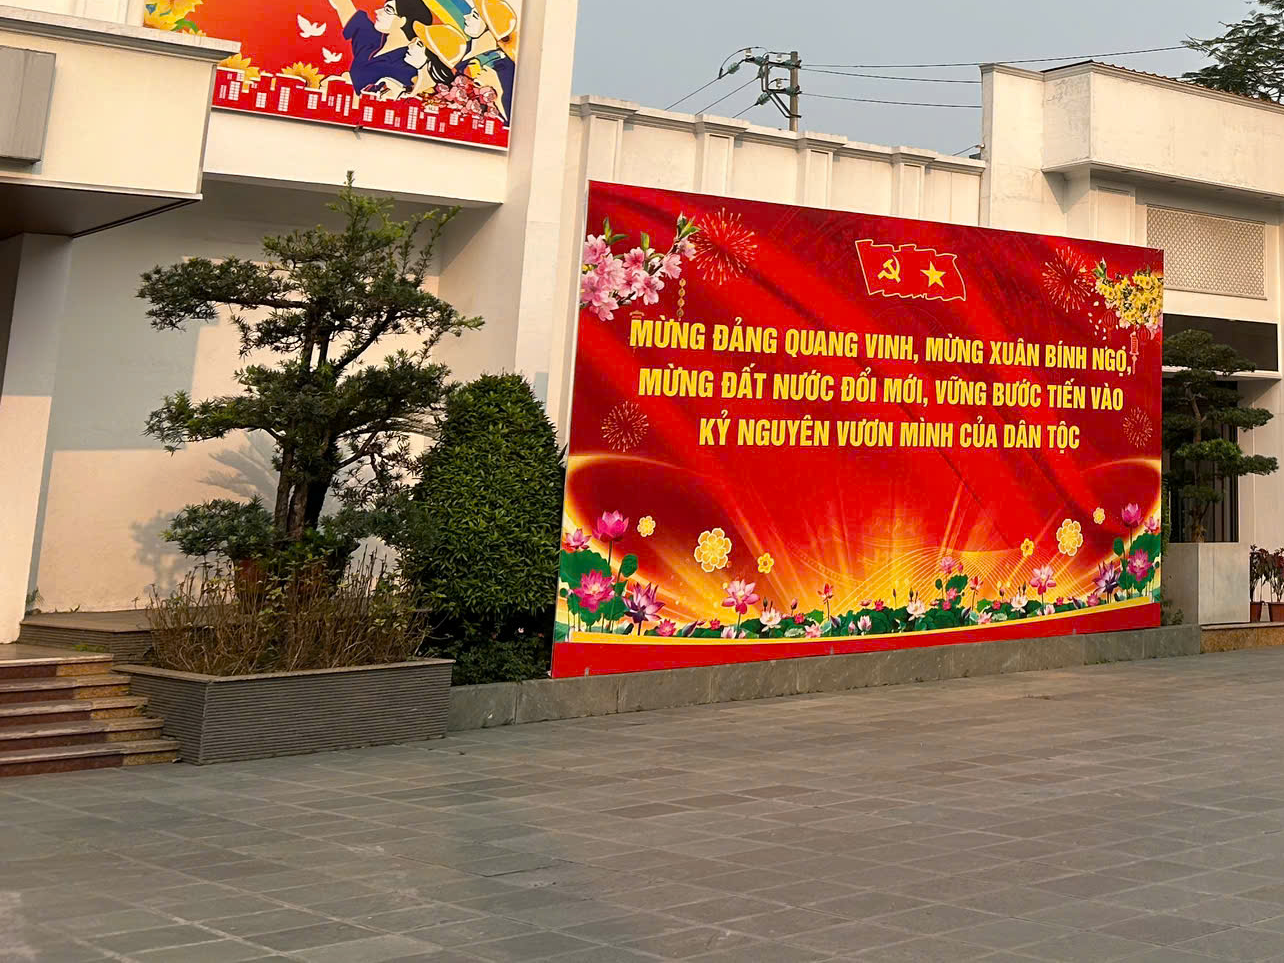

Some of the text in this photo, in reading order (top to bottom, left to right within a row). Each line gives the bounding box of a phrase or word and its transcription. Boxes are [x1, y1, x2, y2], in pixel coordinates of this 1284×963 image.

[629, 315, 1132, 377] MỪNG ĐẢNG QUANG VINH, MỪNG XUÂN BÍNH NGỌ,
[638, 363, 1124, 411] MỪNG ĐẤT NƯỚC ĐỔI MỚI, VỮNG BƯỚC TIẾN VÀO
[699, 409, 1080, 454] KỶ NGUYÊN VƯƠN MÌNH CỦA DÂN TỘC
